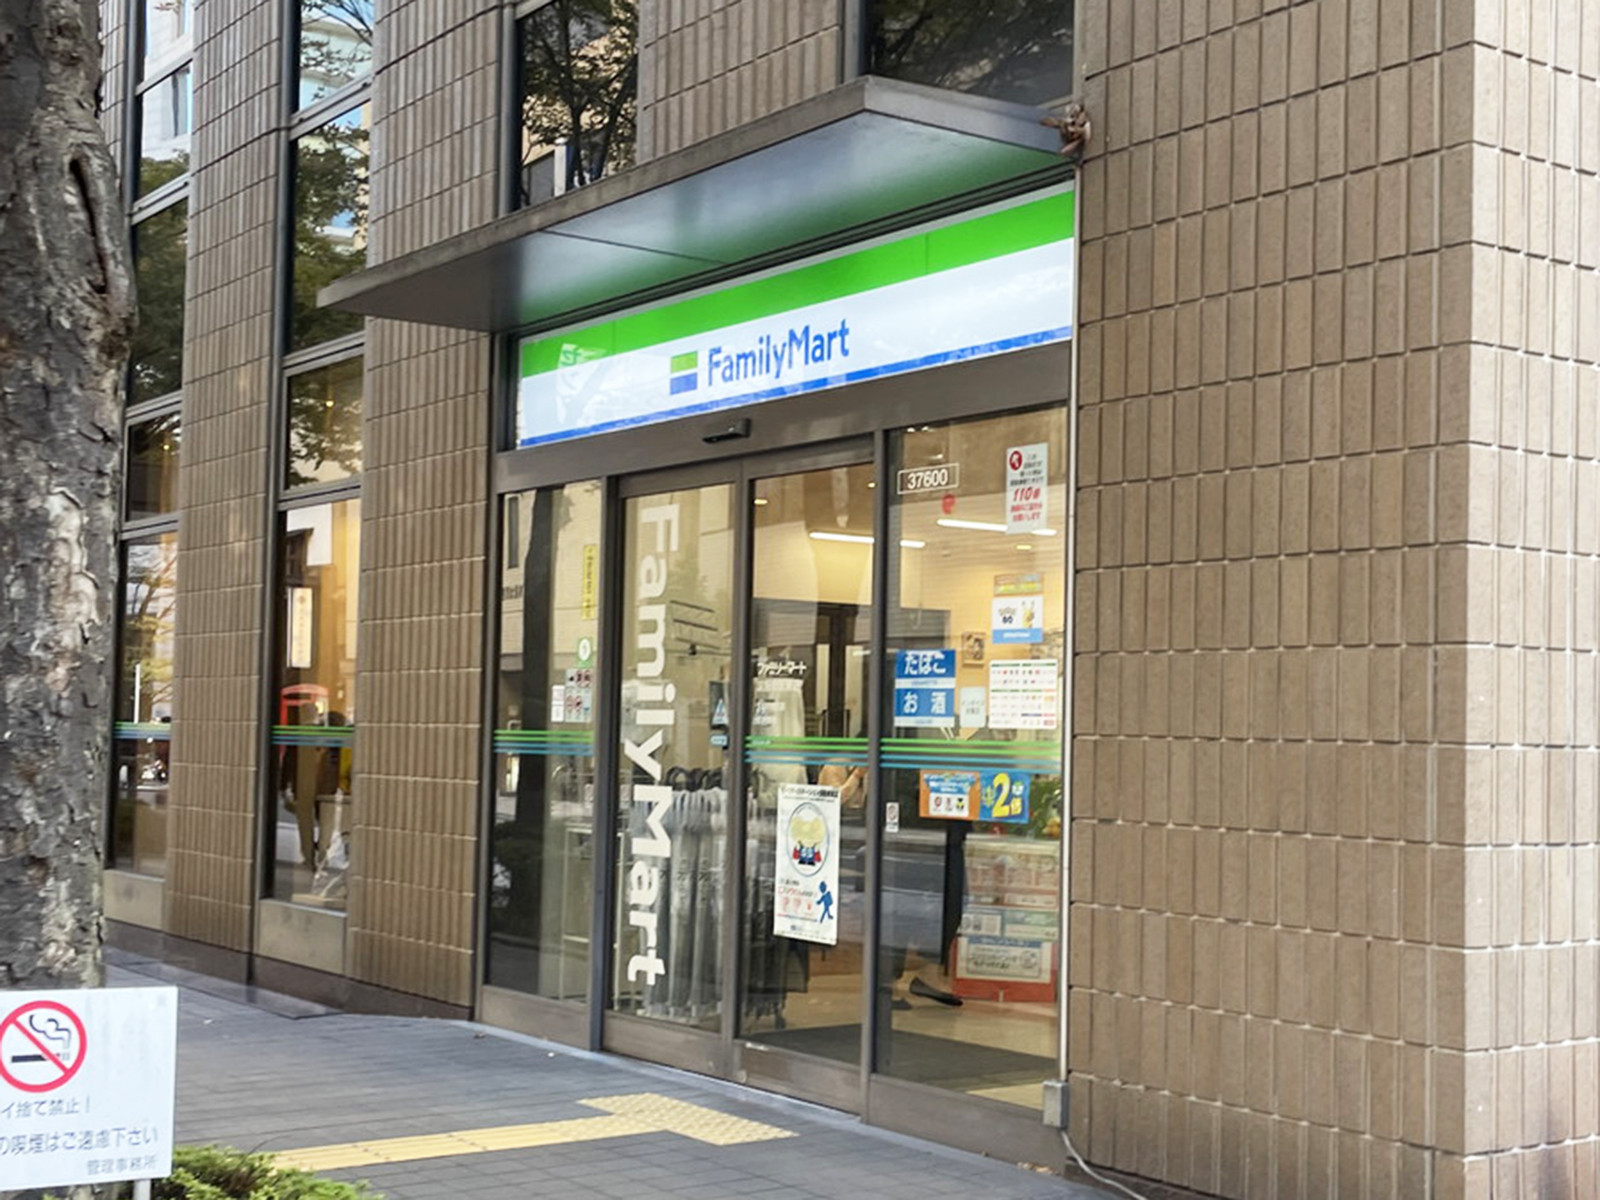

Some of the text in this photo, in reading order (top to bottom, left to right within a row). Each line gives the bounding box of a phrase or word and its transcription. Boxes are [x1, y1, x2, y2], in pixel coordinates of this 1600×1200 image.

[708, 319, 849, 386] FamilyMart
[907, 469, 948, 489] 37600
[904, 651, 946, 676] たばこ
[623, 504, 680, 985] FamilyMart
